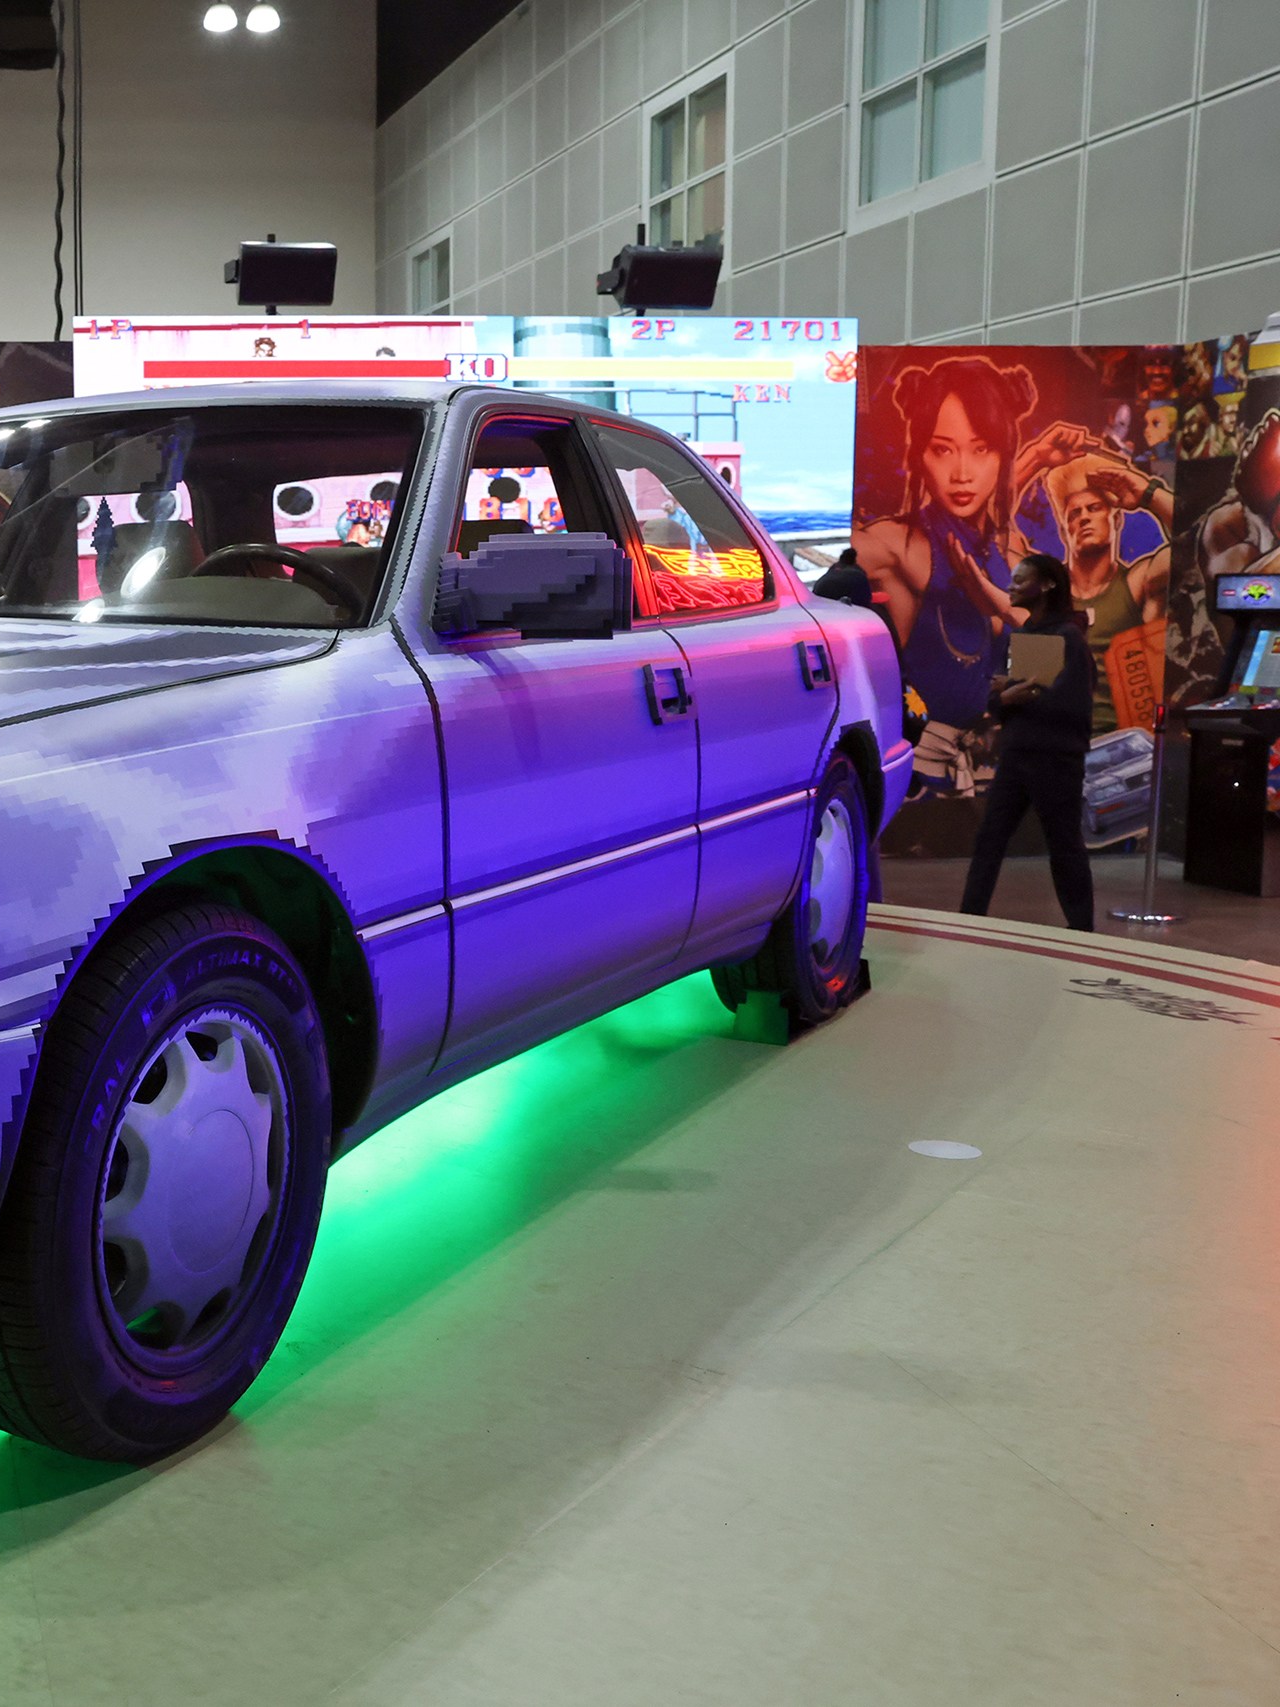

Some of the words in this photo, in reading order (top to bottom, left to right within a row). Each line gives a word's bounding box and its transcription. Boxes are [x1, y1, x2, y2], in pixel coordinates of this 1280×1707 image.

[298, 319, 311, 339] 1
[631, 319, 675, 340] 2P
[733, 320, 841, 341] 21701
[445, 353, 508, 382] KO
[732, 384, 791, 403] KEN
